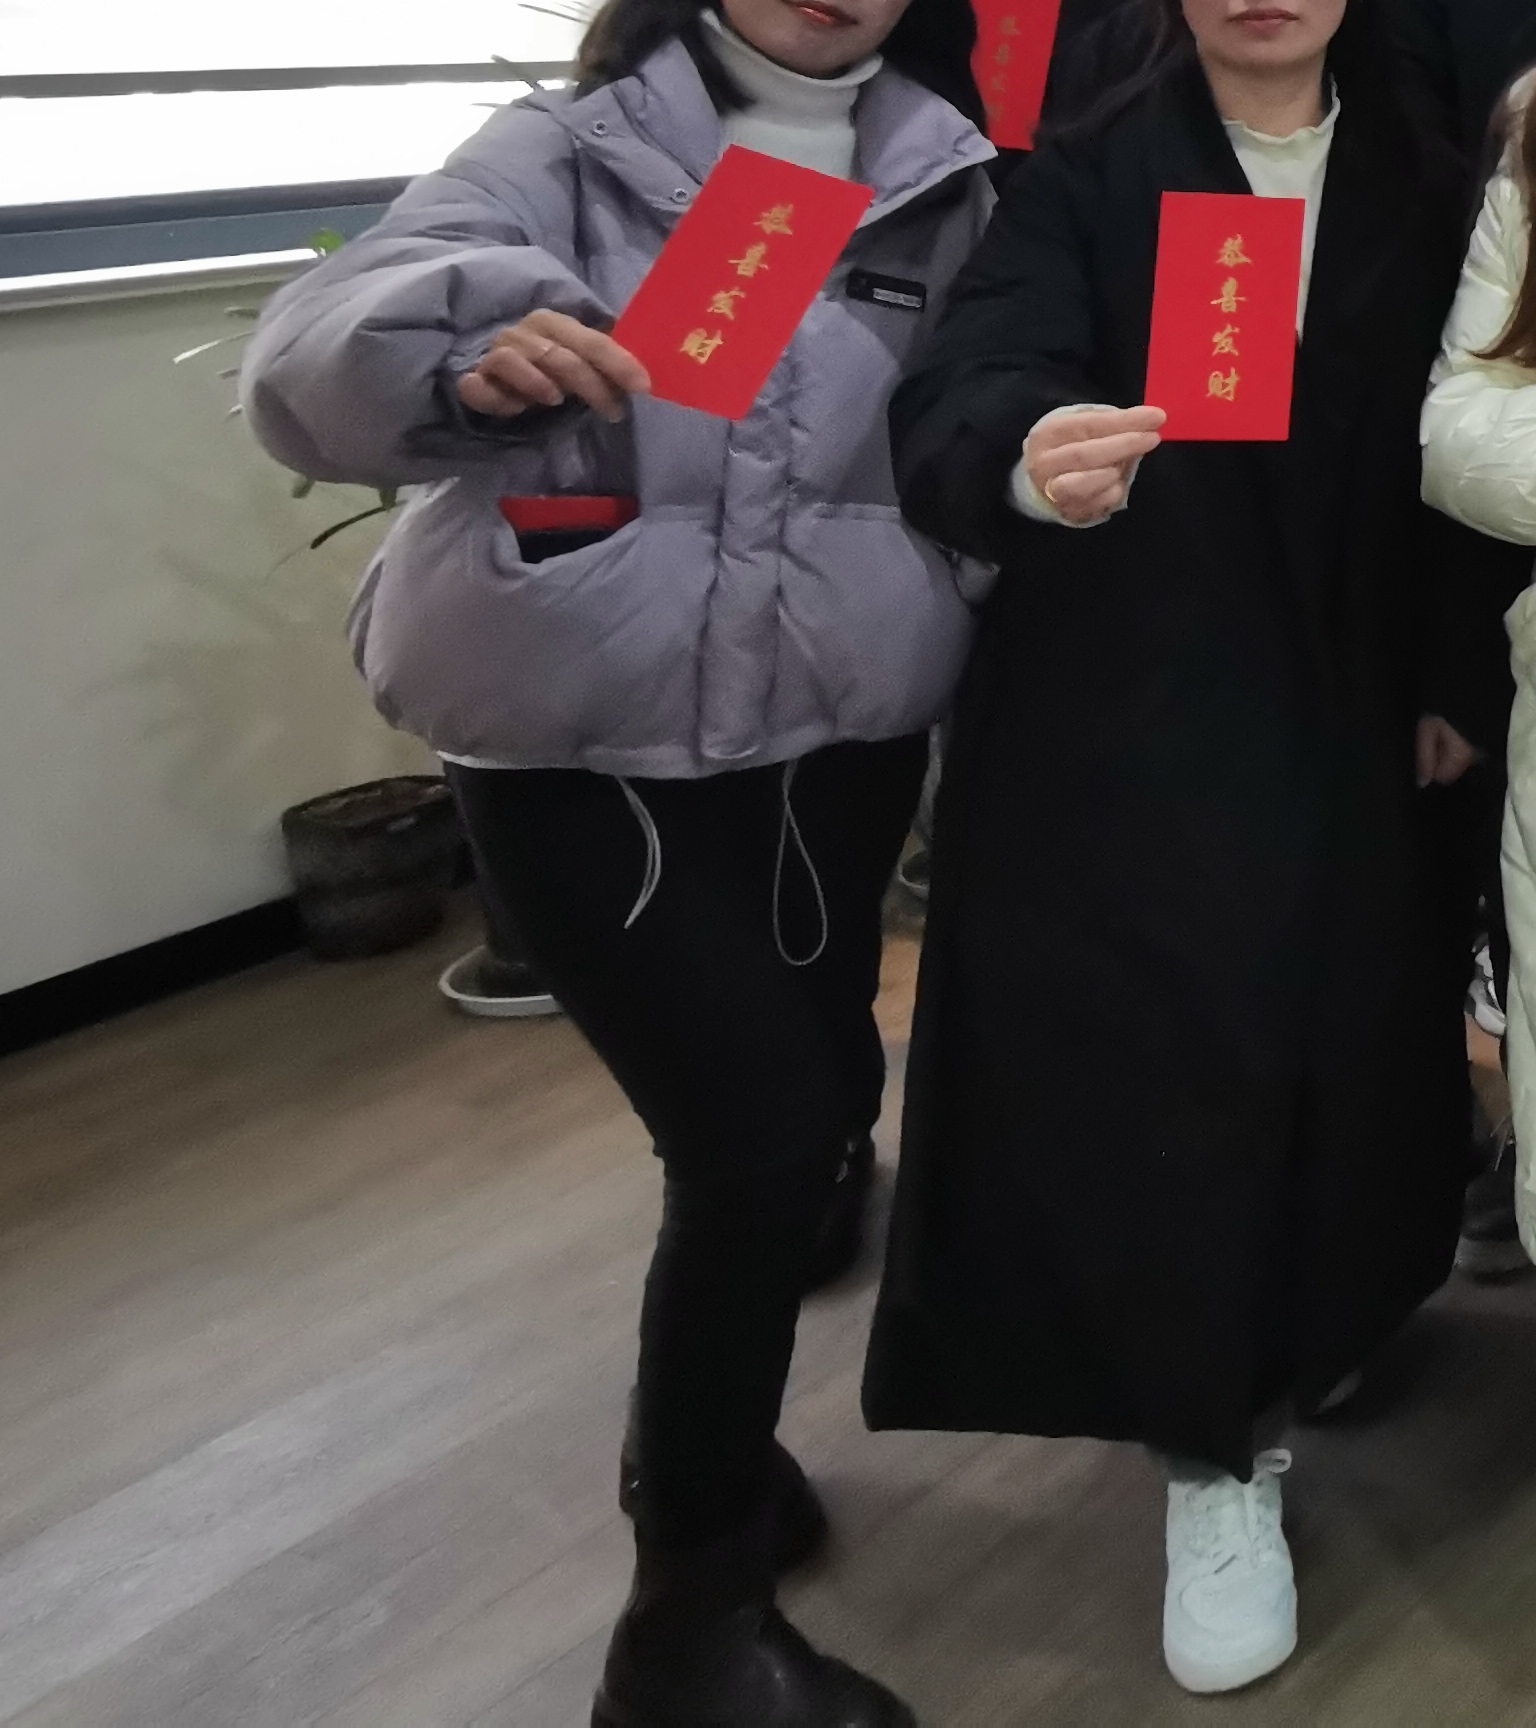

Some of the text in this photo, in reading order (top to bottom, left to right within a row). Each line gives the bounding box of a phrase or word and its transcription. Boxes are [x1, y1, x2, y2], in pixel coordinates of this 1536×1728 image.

[680, 203, 794, 365] 恭喜发财
[1206, 233, 1252, 402] 恭喜发财
